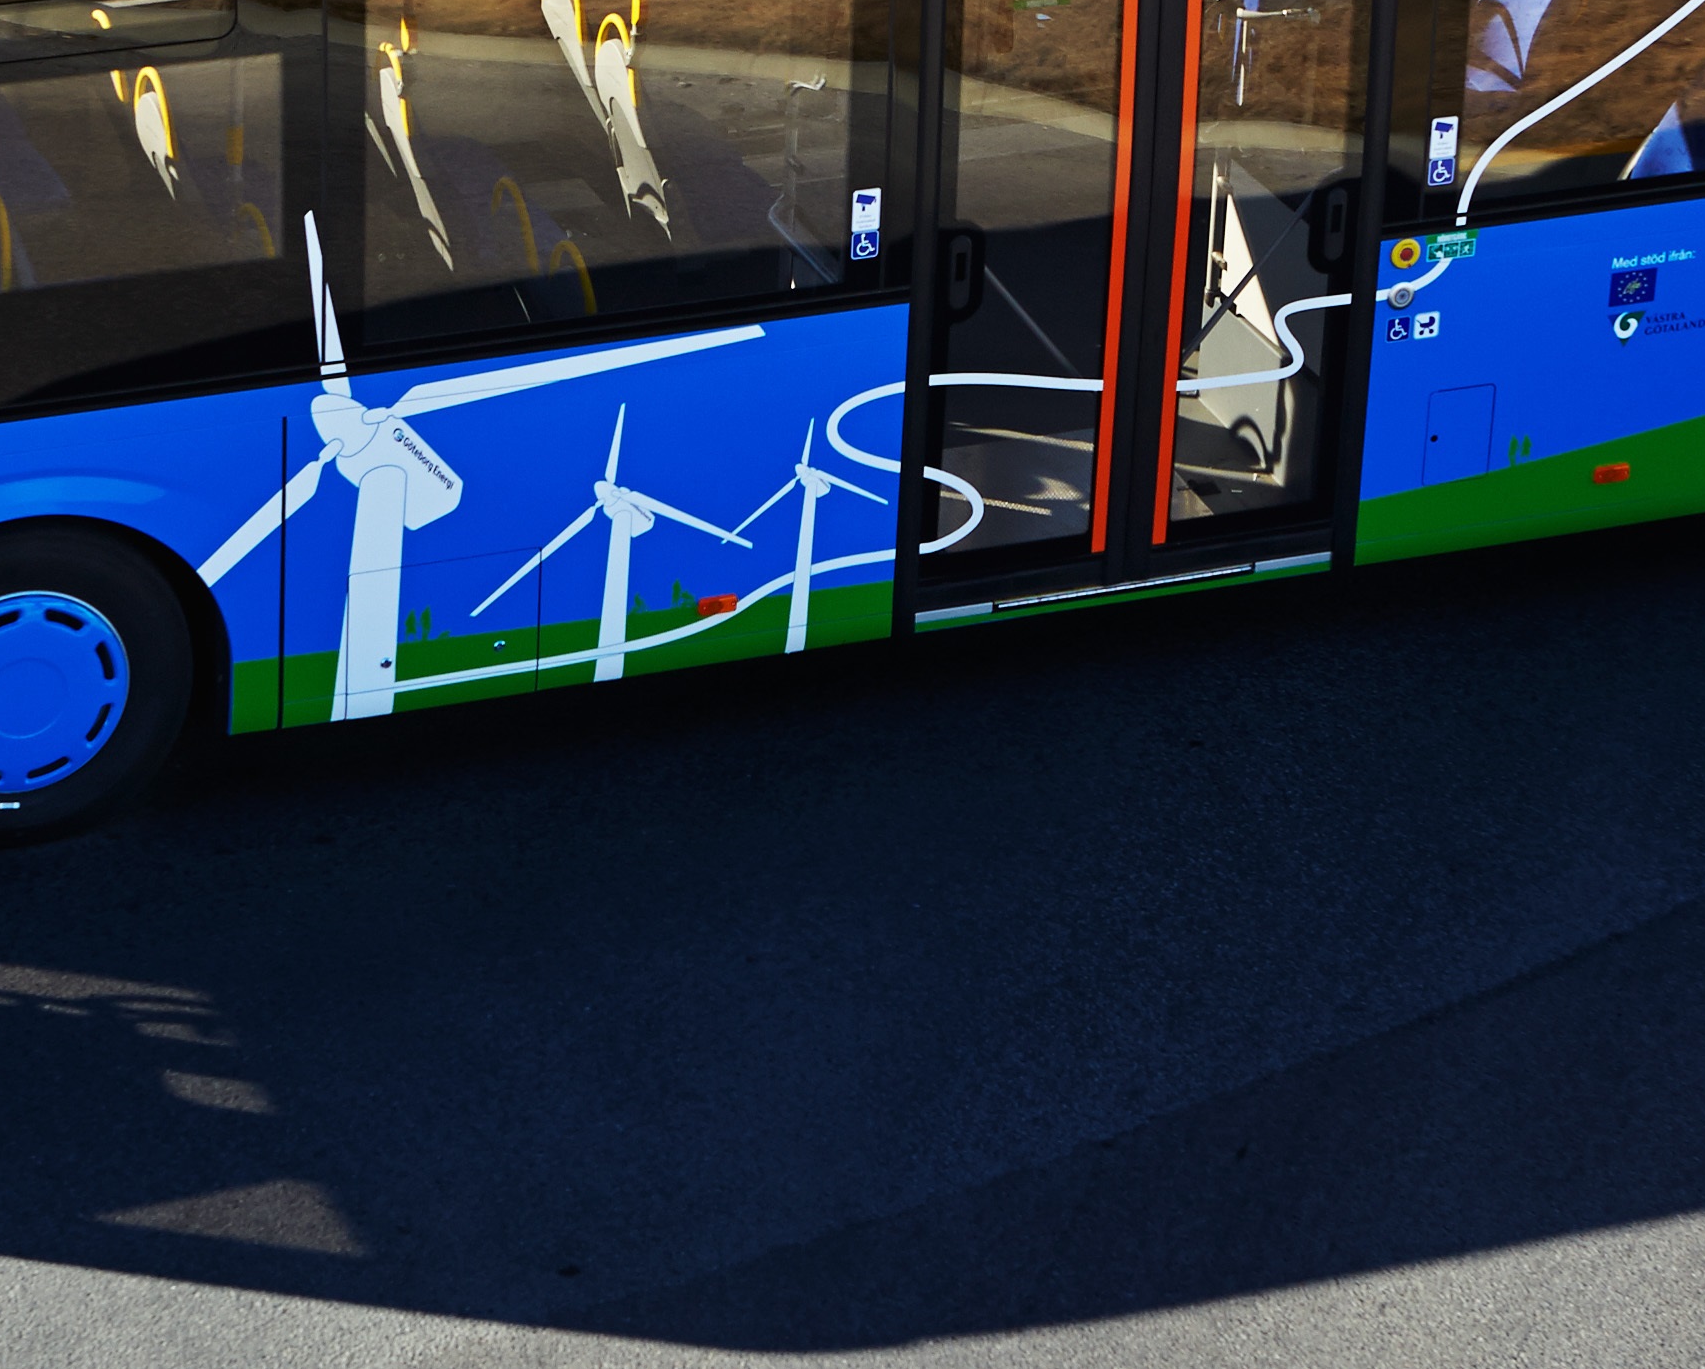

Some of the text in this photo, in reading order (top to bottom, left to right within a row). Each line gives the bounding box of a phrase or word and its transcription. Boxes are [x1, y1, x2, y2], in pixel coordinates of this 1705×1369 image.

[1611, 249, 1696, 269] Med stöd ifrån:
[403, 437, 455, 490] Göteborg Energi
